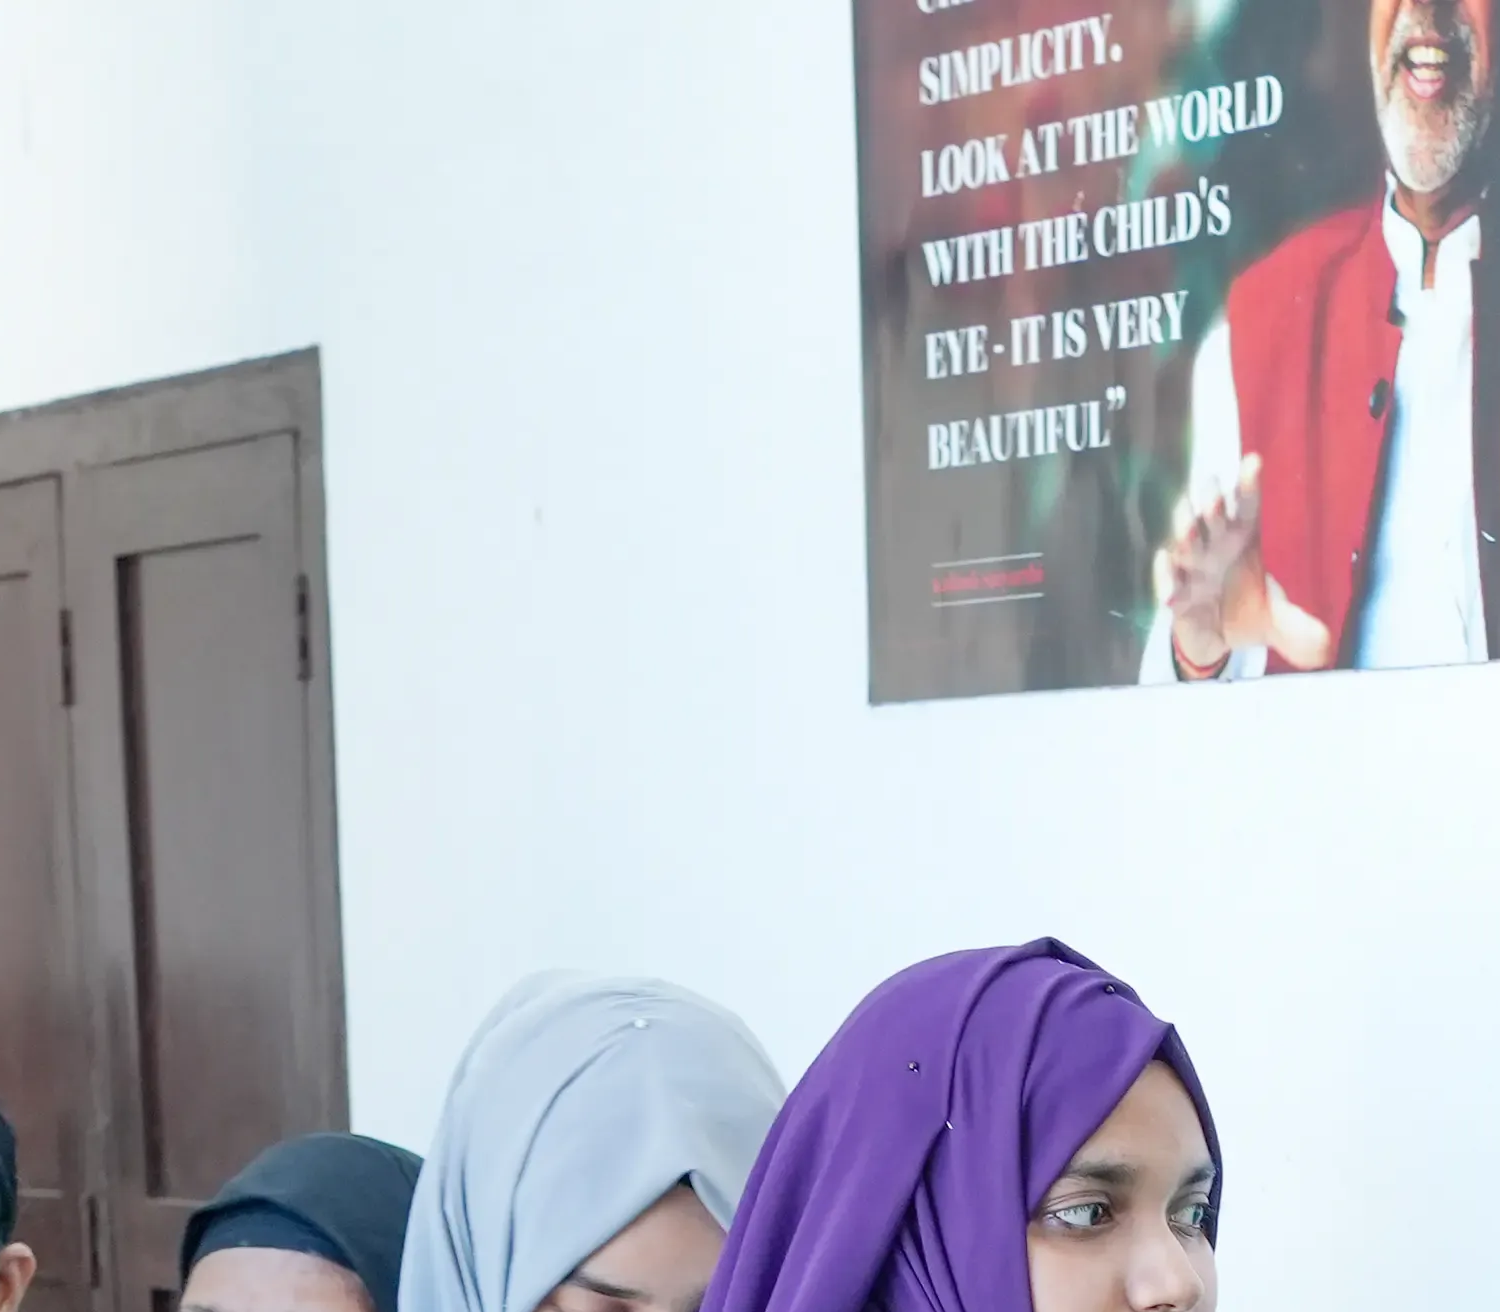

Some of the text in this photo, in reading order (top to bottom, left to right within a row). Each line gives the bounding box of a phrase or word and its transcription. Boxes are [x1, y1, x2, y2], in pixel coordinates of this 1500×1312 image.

[919, 13, 1123, 106] SIMPLICITY.
[921, 74, 1283, 198] LOOK AT THE WORLD
[922, 176, 1232, 288] WITH THE CHILD'S
[925, 324, 989, 380] EYE
[1010, 314, 1046, 366] IT
[1051, 308, 1088, 360] IS
[1092, 290, 1190, 352] VERY
